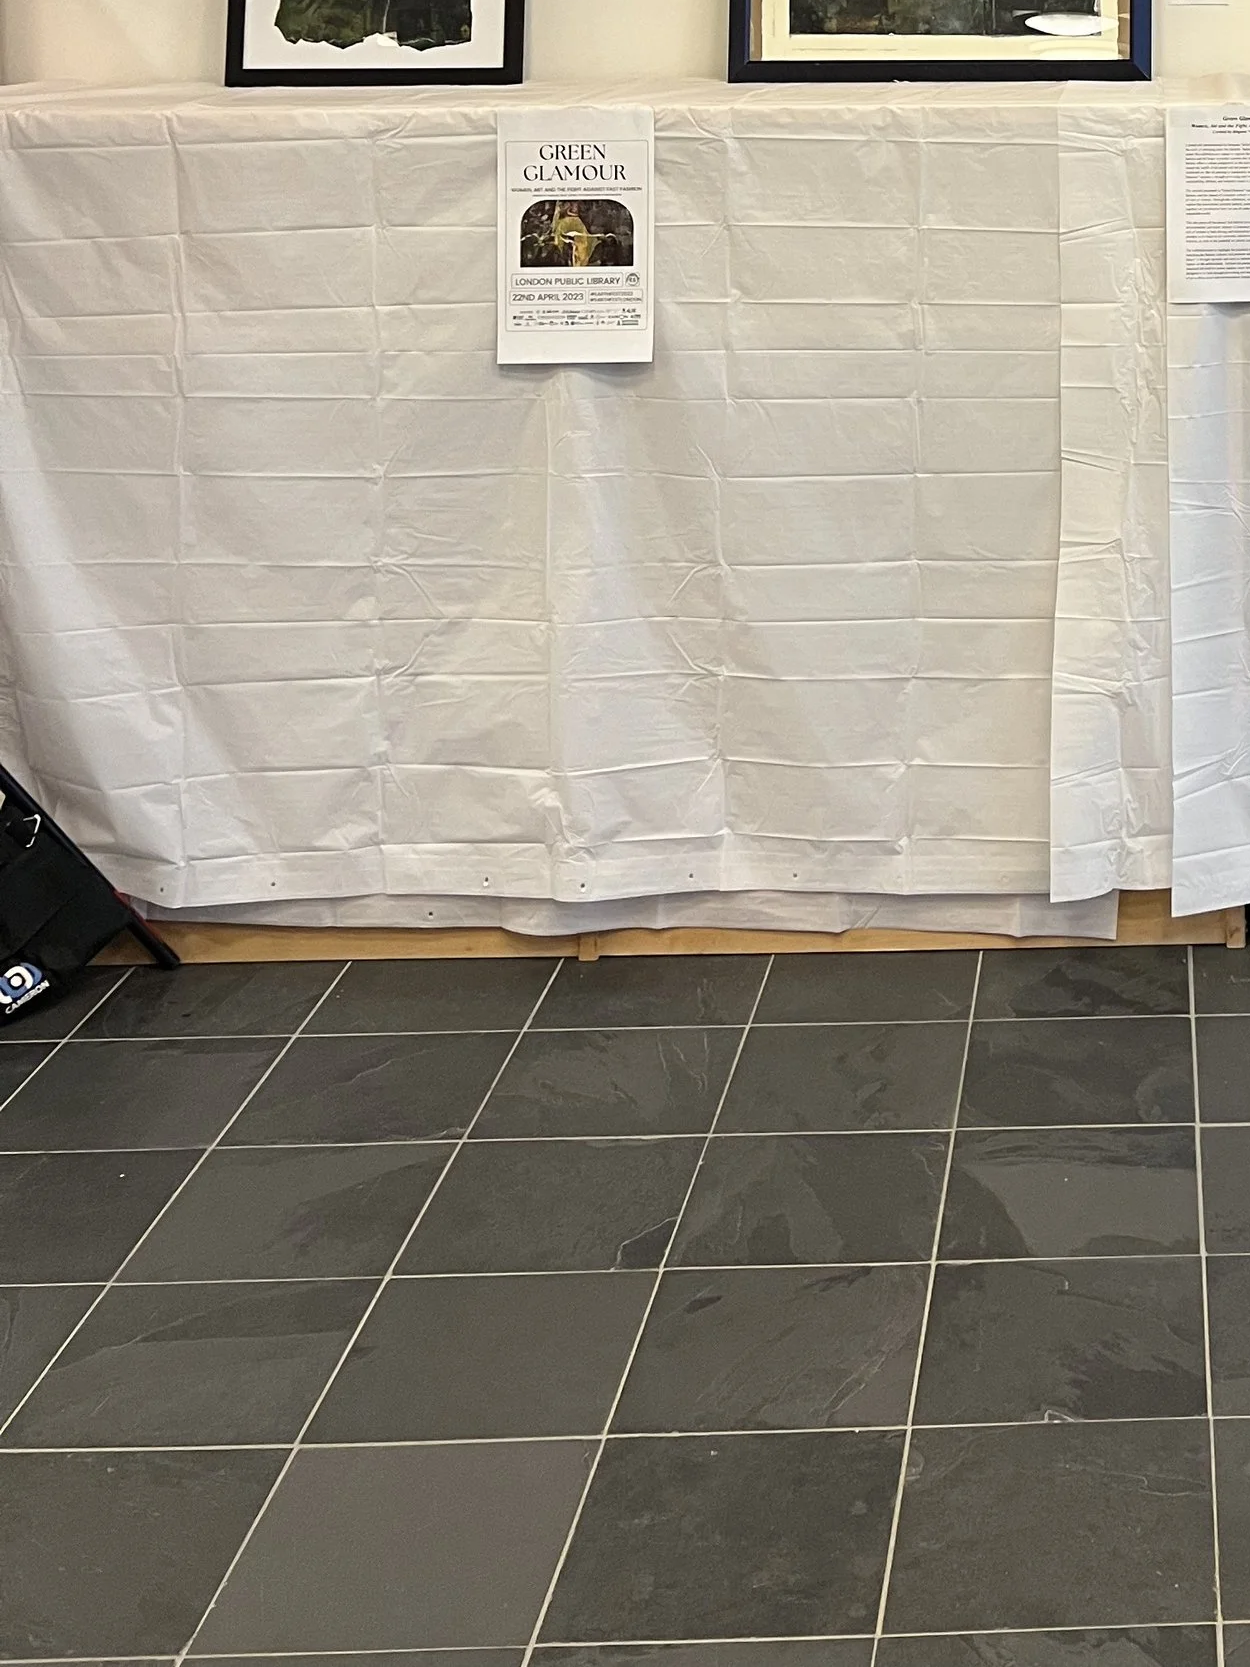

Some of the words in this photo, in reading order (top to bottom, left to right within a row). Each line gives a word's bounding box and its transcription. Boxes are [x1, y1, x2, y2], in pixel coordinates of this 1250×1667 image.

[539, 144, 606, 160] GREEN
[523, 164, 627, 181] GLAMOUR
[515, 278, 552, 286] LONDON
[554, 277, 584, 285] PUBLIC
[586, 277, 620, 285] LIBRARY
[512, 293, 535, 302] 22ND
[537, 293, 560, 301] APRIL
[562, 292, 584, 301] 2023
[5, 979, 50, 1014] CAMERON
